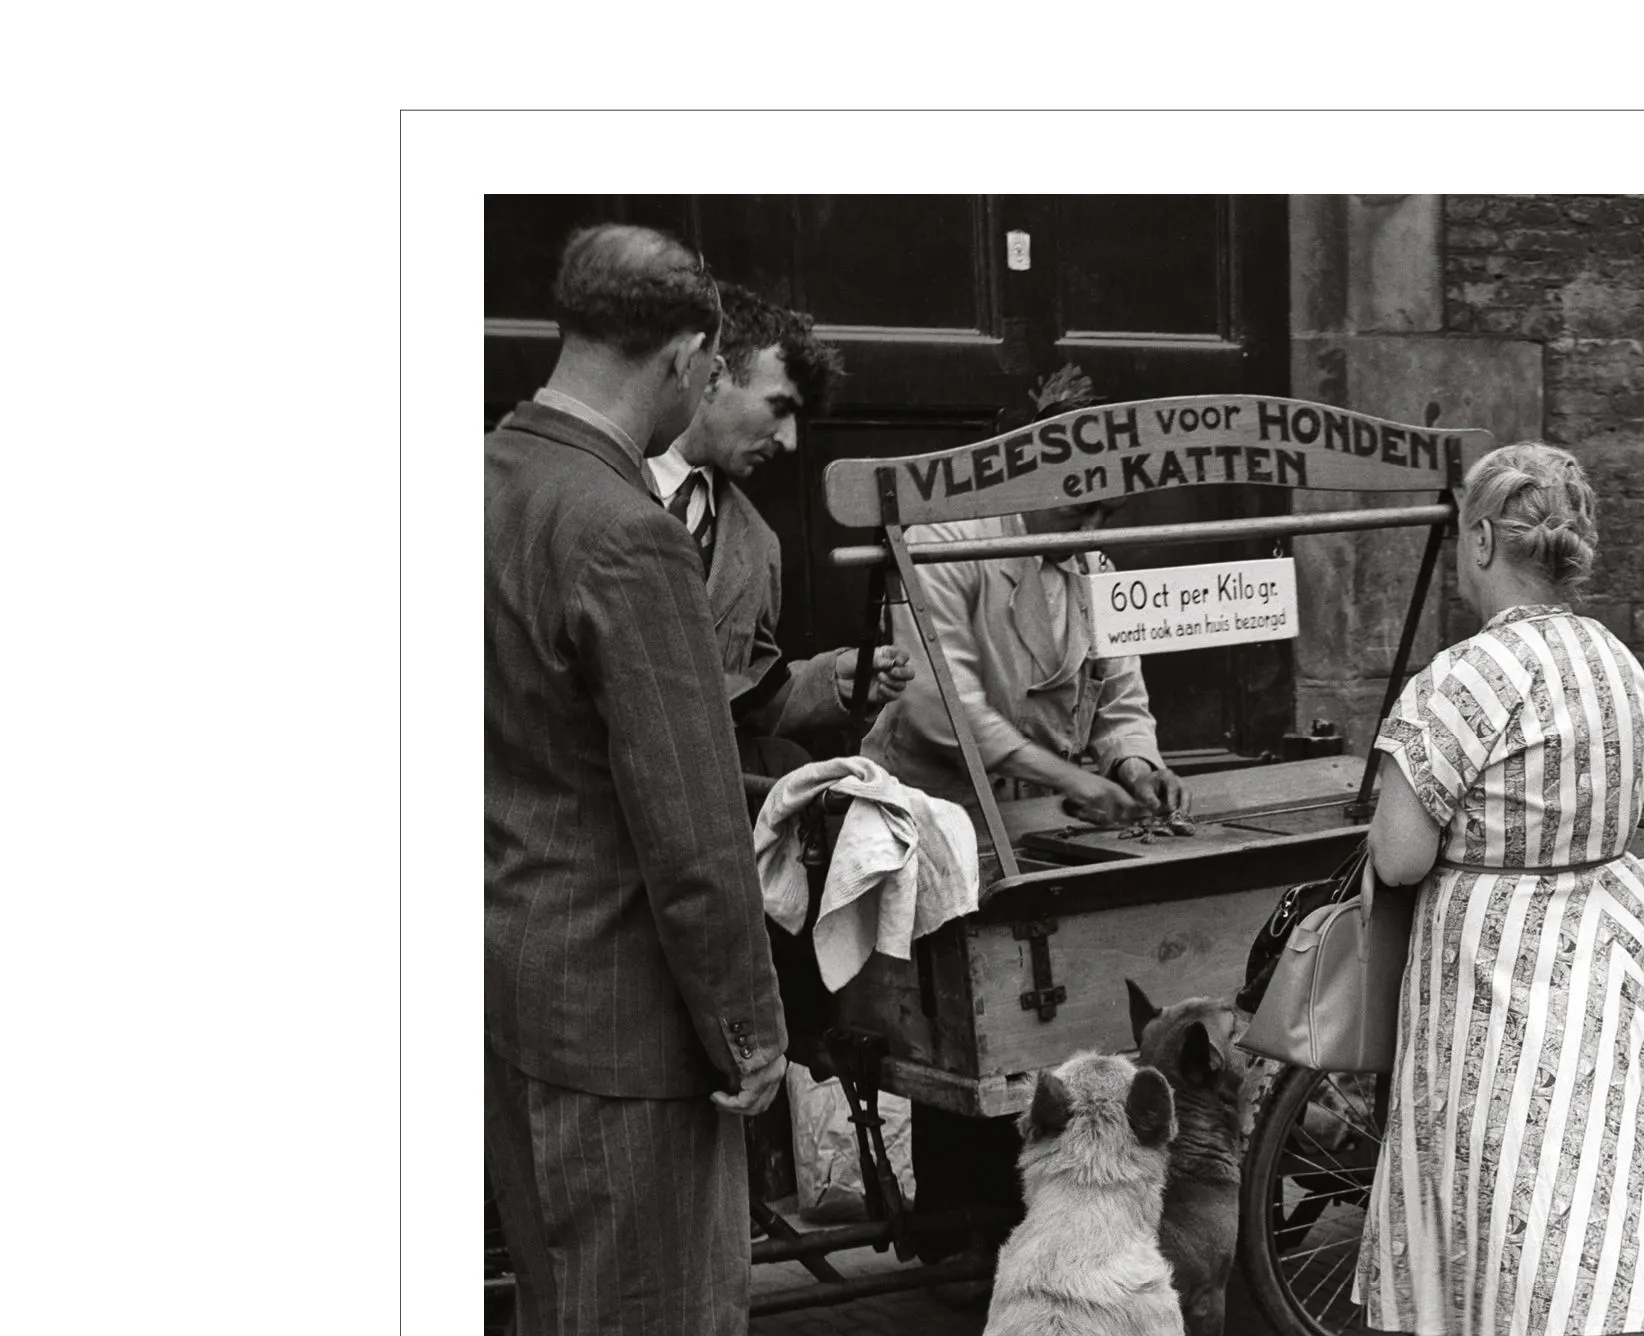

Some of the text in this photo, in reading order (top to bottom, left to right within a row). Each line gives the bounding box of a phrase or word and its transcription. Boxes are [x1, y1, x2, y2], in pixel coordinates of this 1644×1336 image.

[905, 401, 1441, 501] VLEESCH voor HONDEN
[1063, 445, 1308, 499] en KATTEN
[1180, 587, 1210, 613] per
[1108, 607, 1288, 644] wordt ook aan huis bezorgd
